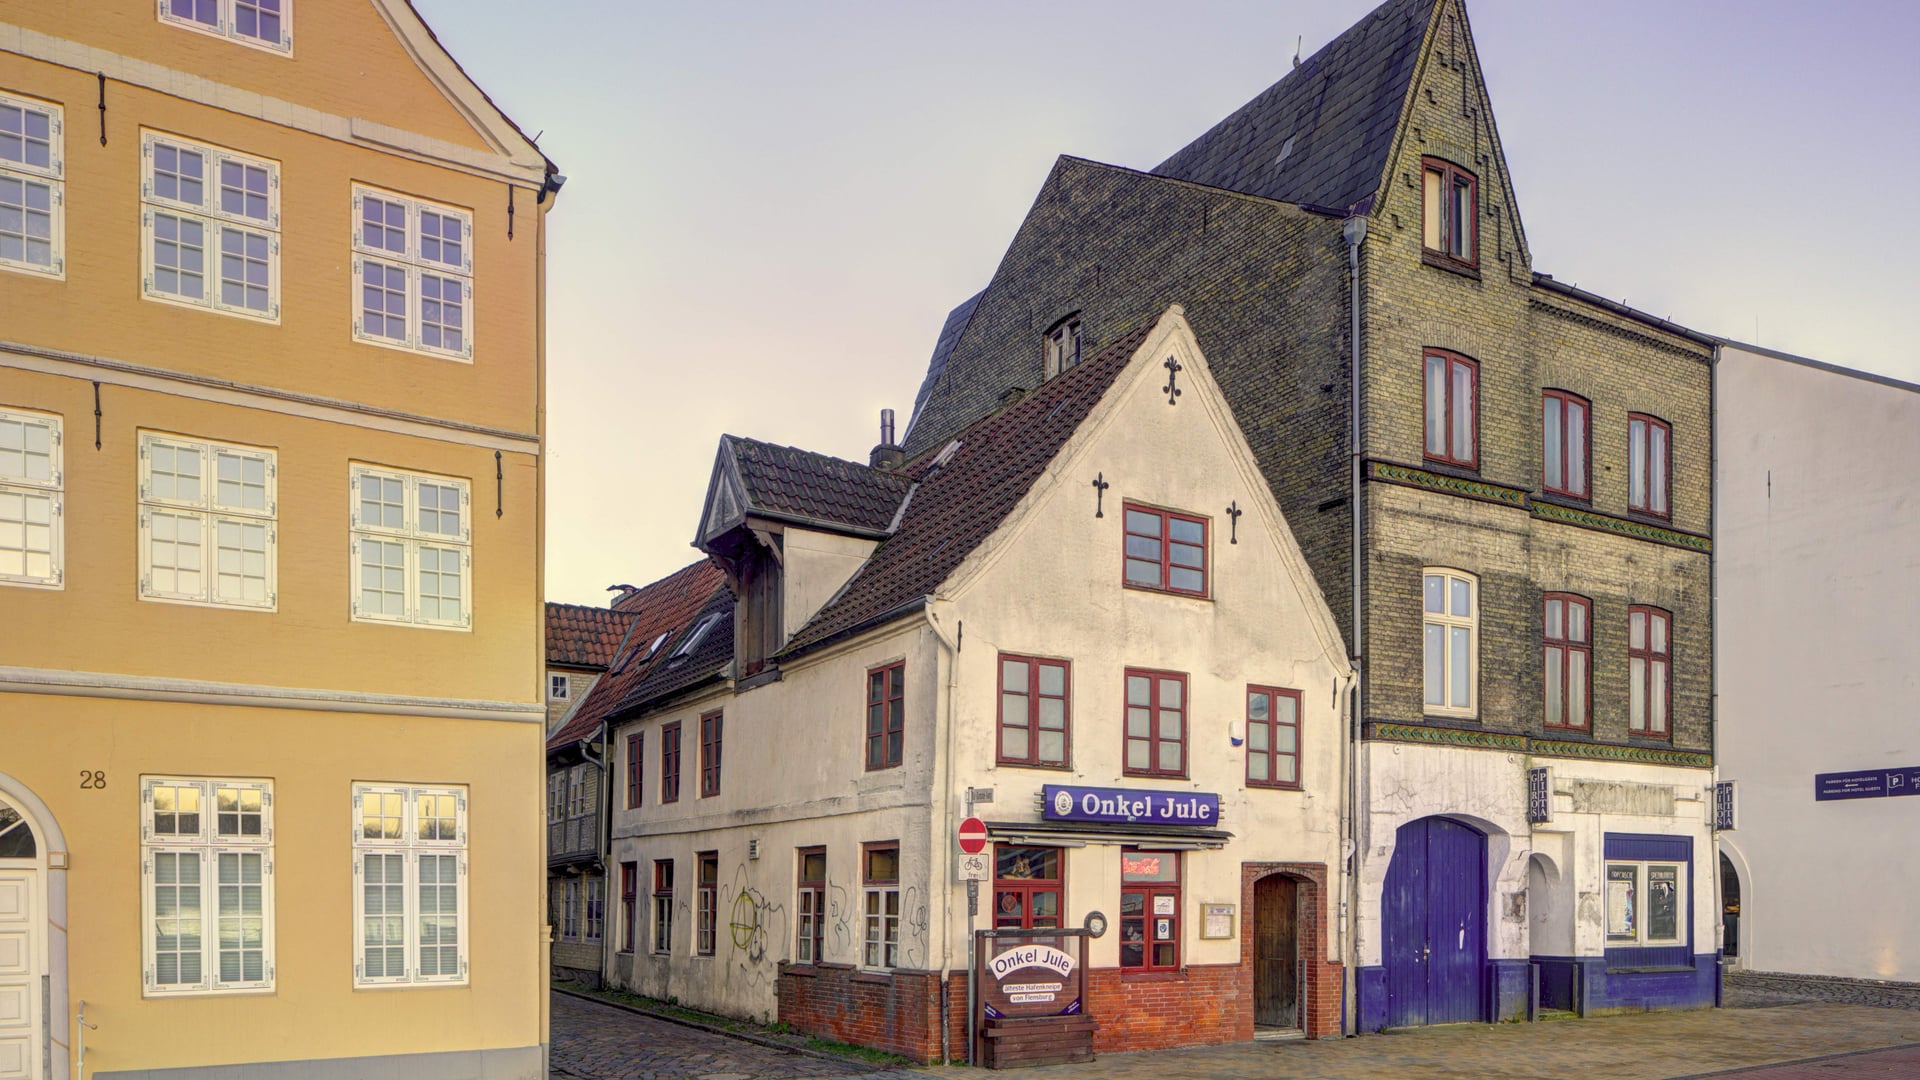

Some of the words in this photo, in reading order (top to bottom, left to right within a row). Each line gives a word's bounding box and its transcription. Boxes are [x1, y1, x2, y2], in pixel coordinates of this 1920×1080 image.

[80, 770, 106, 789] 28
[1892, 777, 1899, 786] P
[1082, 793, 1152, 817] Onkel
[1160, 797, 1210, 819] Jule
[968, 870, 979, 878] frei
[995, 948, 1037, 973] Onkel
[1042, 950, 1069, 972] Jule
[1025, 983, 1061, 991] Hafenkneipe
